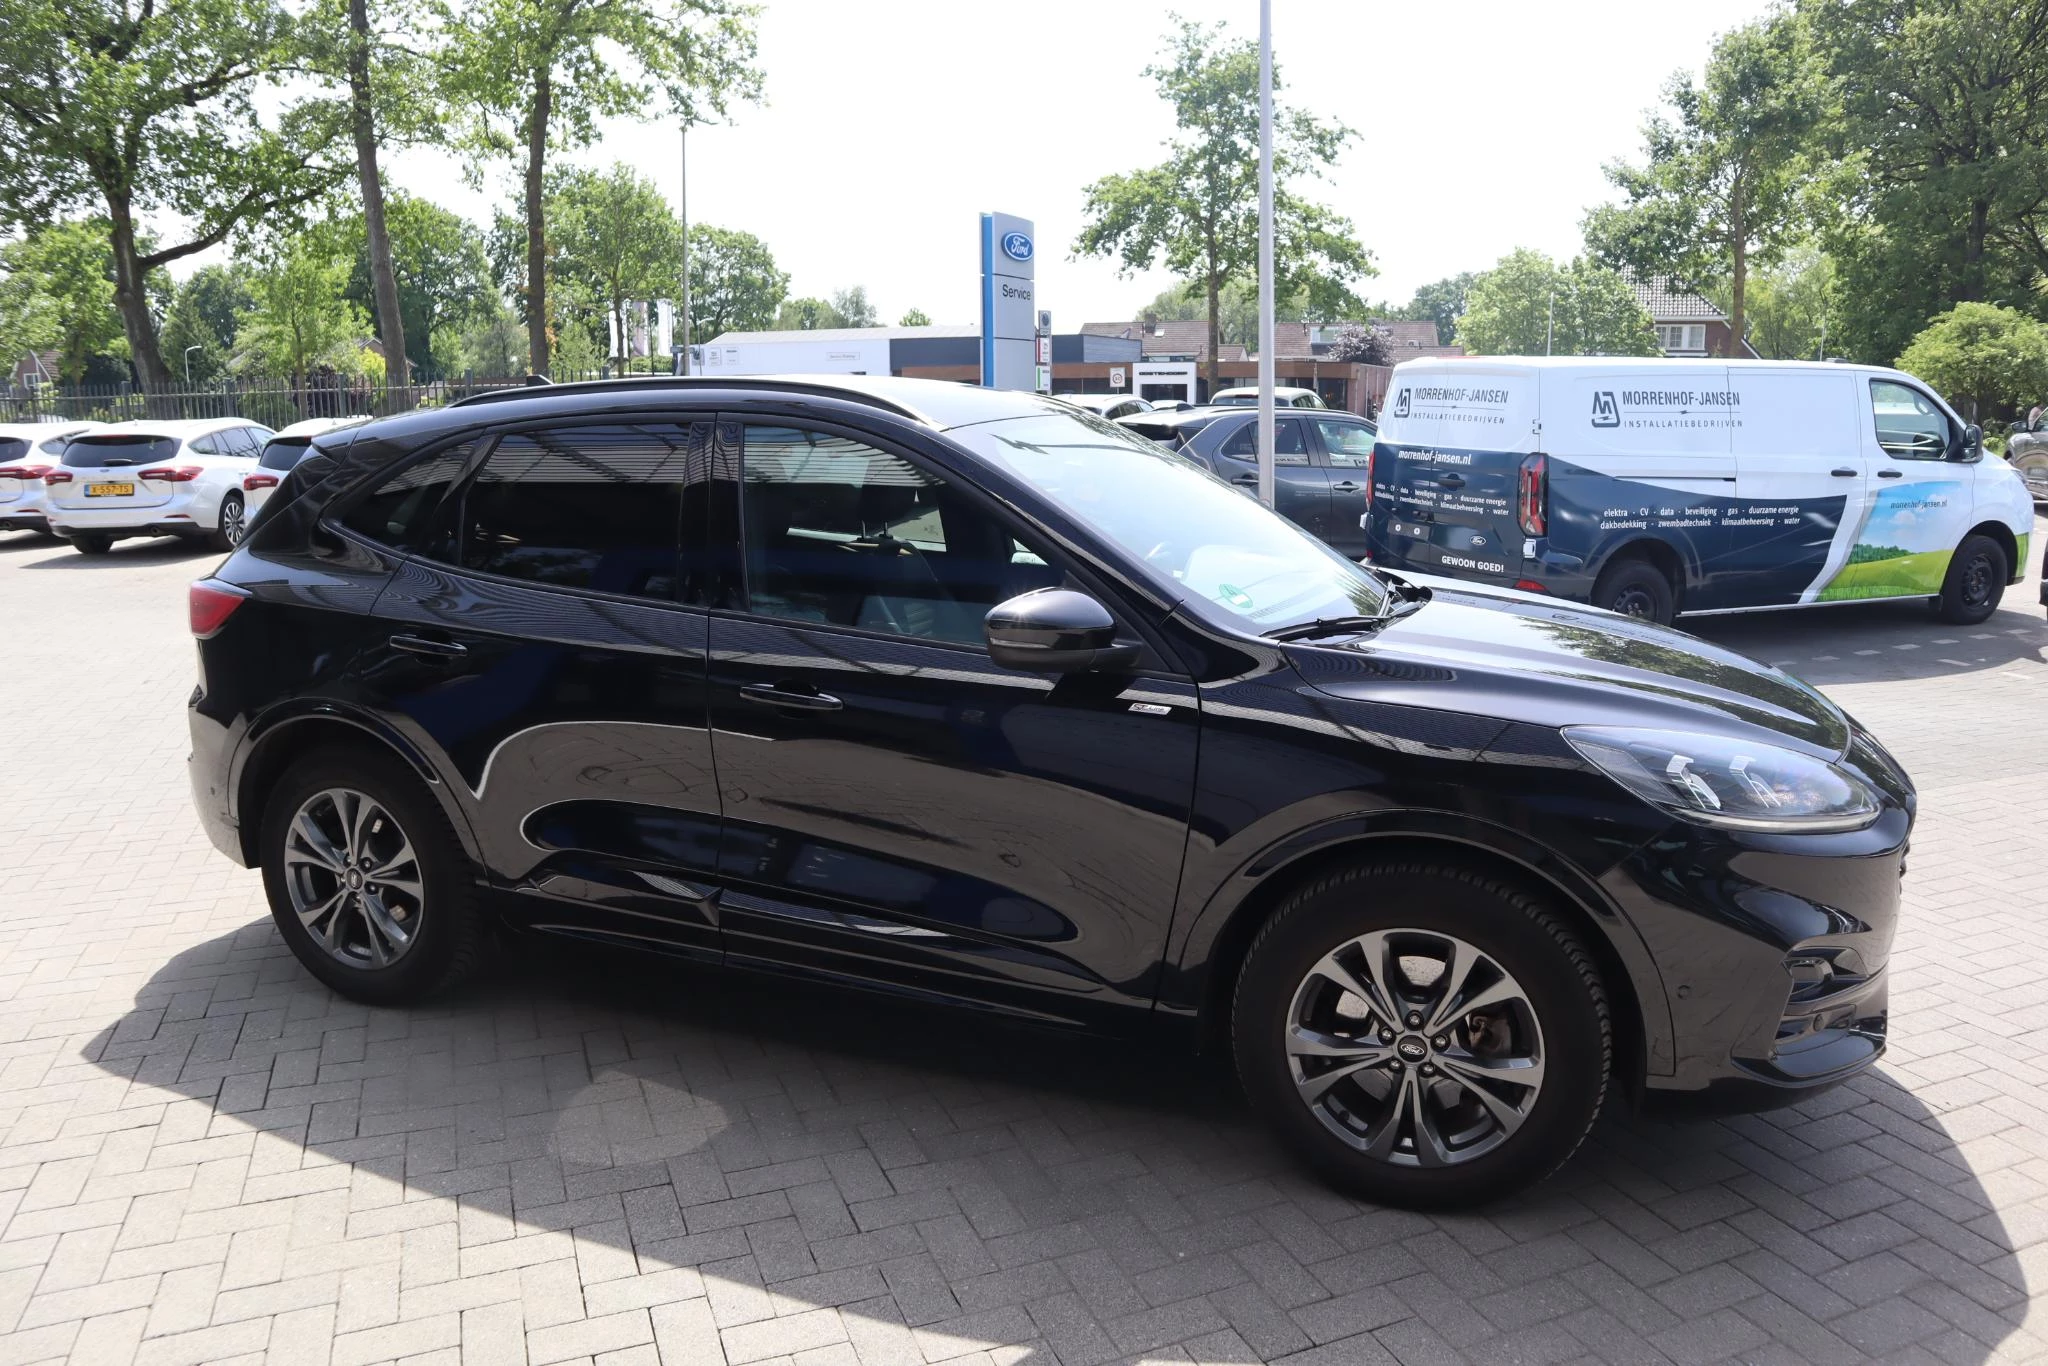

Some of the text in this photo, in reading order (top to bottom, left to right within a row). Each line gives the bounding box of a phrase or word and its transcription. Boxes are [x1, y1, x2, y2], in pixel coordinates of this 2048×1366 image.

[1010, 235, 1031, 256] Ford
[1002, 284, 1031, 301] Service
[1414, 387, 1509, 404] MORRENHOF-JANSEN
[1622, 390, 1741, 406] MORRENHOF-JANSEN
[1411, 413, 1504, 425] INSTALLATIEBEDRIJVEN
[1623, 419, 1743, 428] INSTALLATIEBEDRIJVEN
[1398, 450, 1472, 466] morrenhof-jansen.nl
[1400, 487, 1409, 495] data
[1414, 488, 1437, 500] beveiliging
[1443, 493, 1453, 501] gas
[1460, 495, 1485, 504] duurzame
[1485, 498, 1507, 507] energie
[1440, 501, 1484, 514] klimaatbeheersing
[1493, 508, 1510, 516] water
[1603, 504, 1800, 518] elektra CV data beveiliging gas duurzame energie
[1600, 515, 1801, 530] dakbedekking zwembadtechniek klimaatbeheersing water
[1441, 555, 1505, 573] GEWOON GOED!
